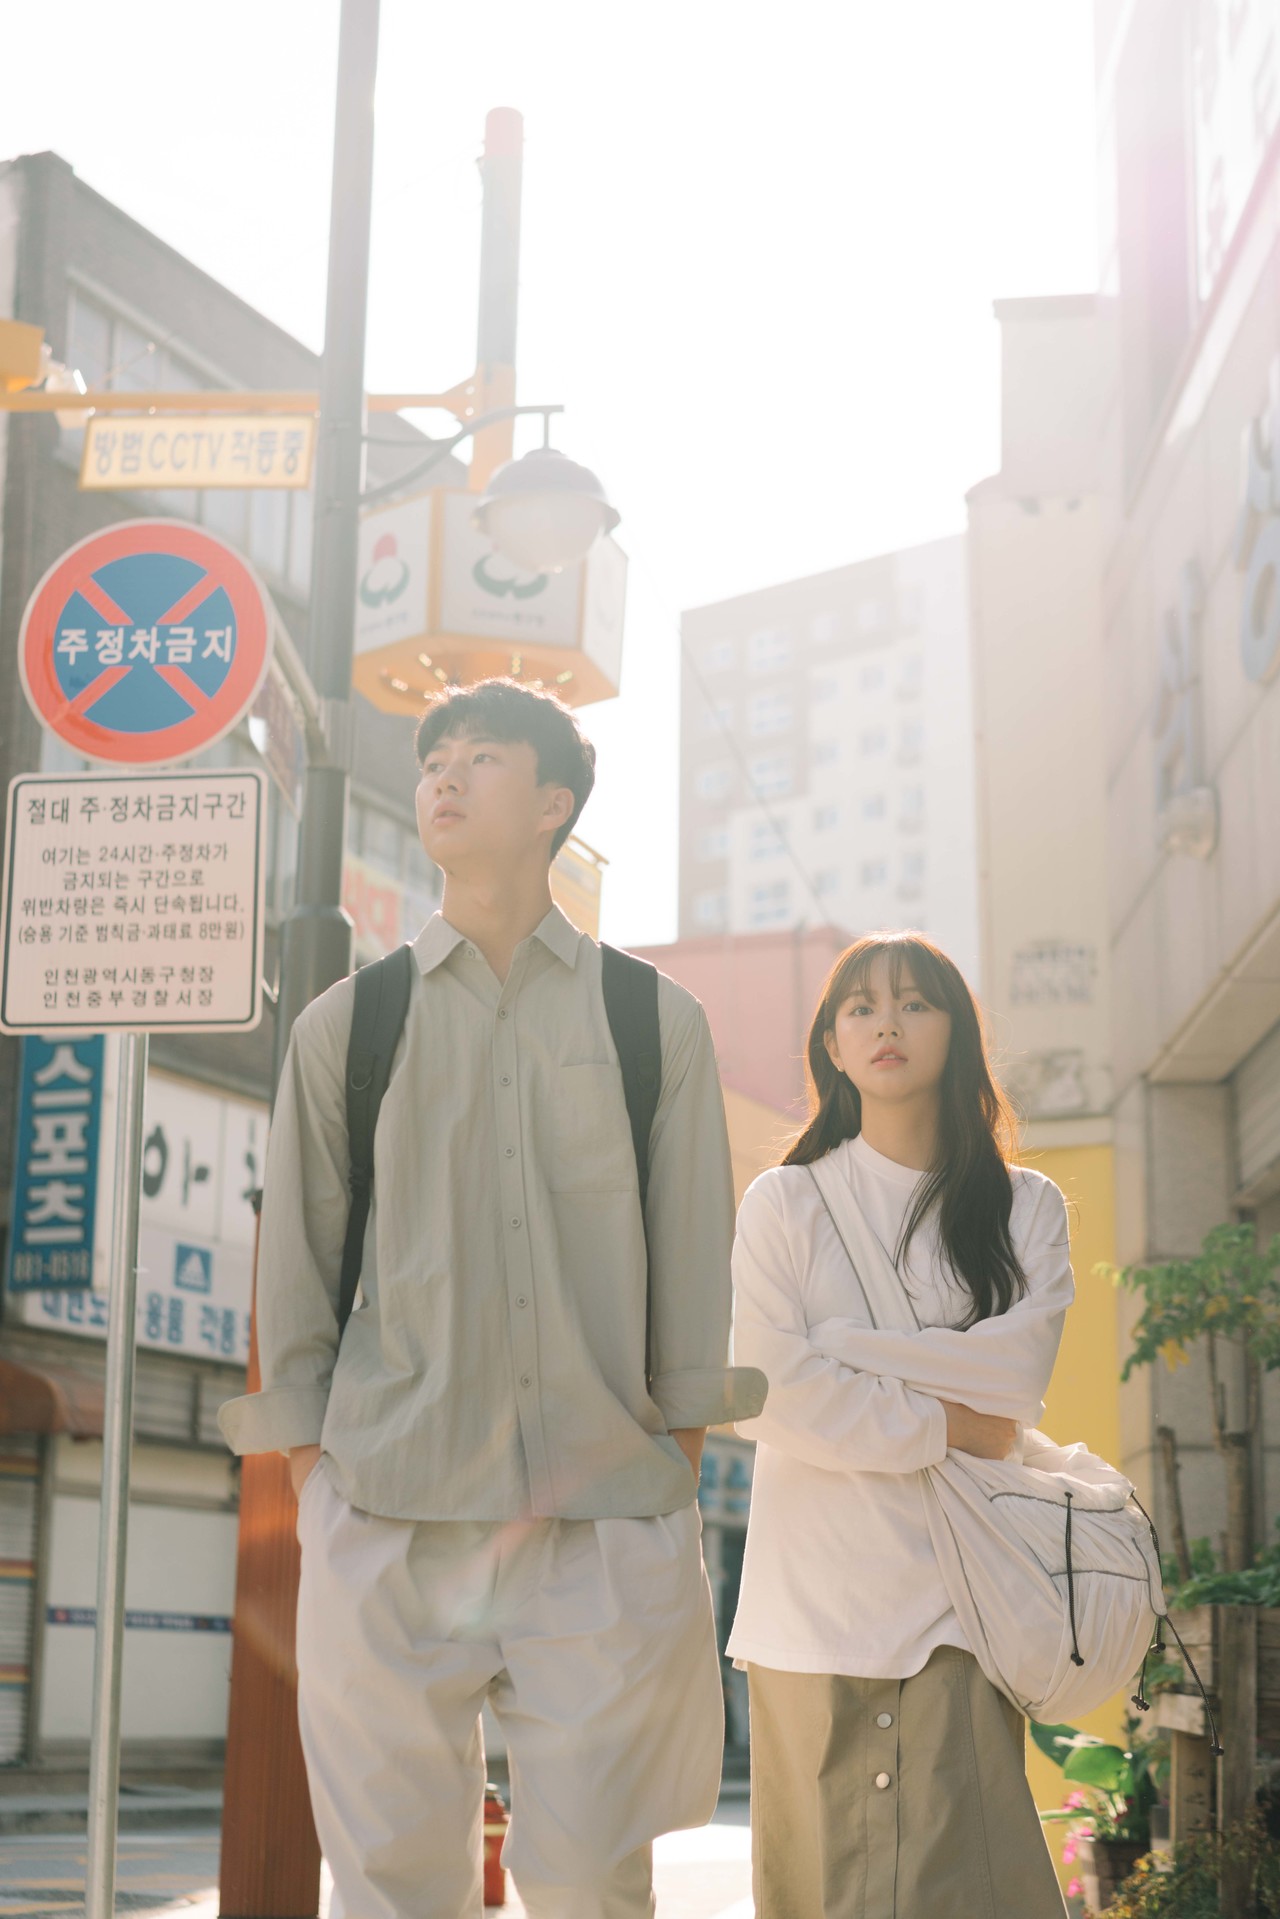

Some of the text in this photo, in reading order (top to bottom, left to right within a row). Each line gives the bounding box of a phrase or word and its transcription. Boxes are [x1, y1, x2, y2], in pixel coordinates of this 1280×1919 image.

[56, 625, 233, 667] 주정차금지
[27, 797, 70, 825] 절대
[41, 846, 92, 866] 여기는
[62, 868, 205, 892] 금지되는 구간으로
[20, 897, 106, 917] 위반차량은
[113, 895, 146, 915] 즉시
[58, 923, 89, 944] 기준
[23, 1034, 94, 1244] 스포츠
